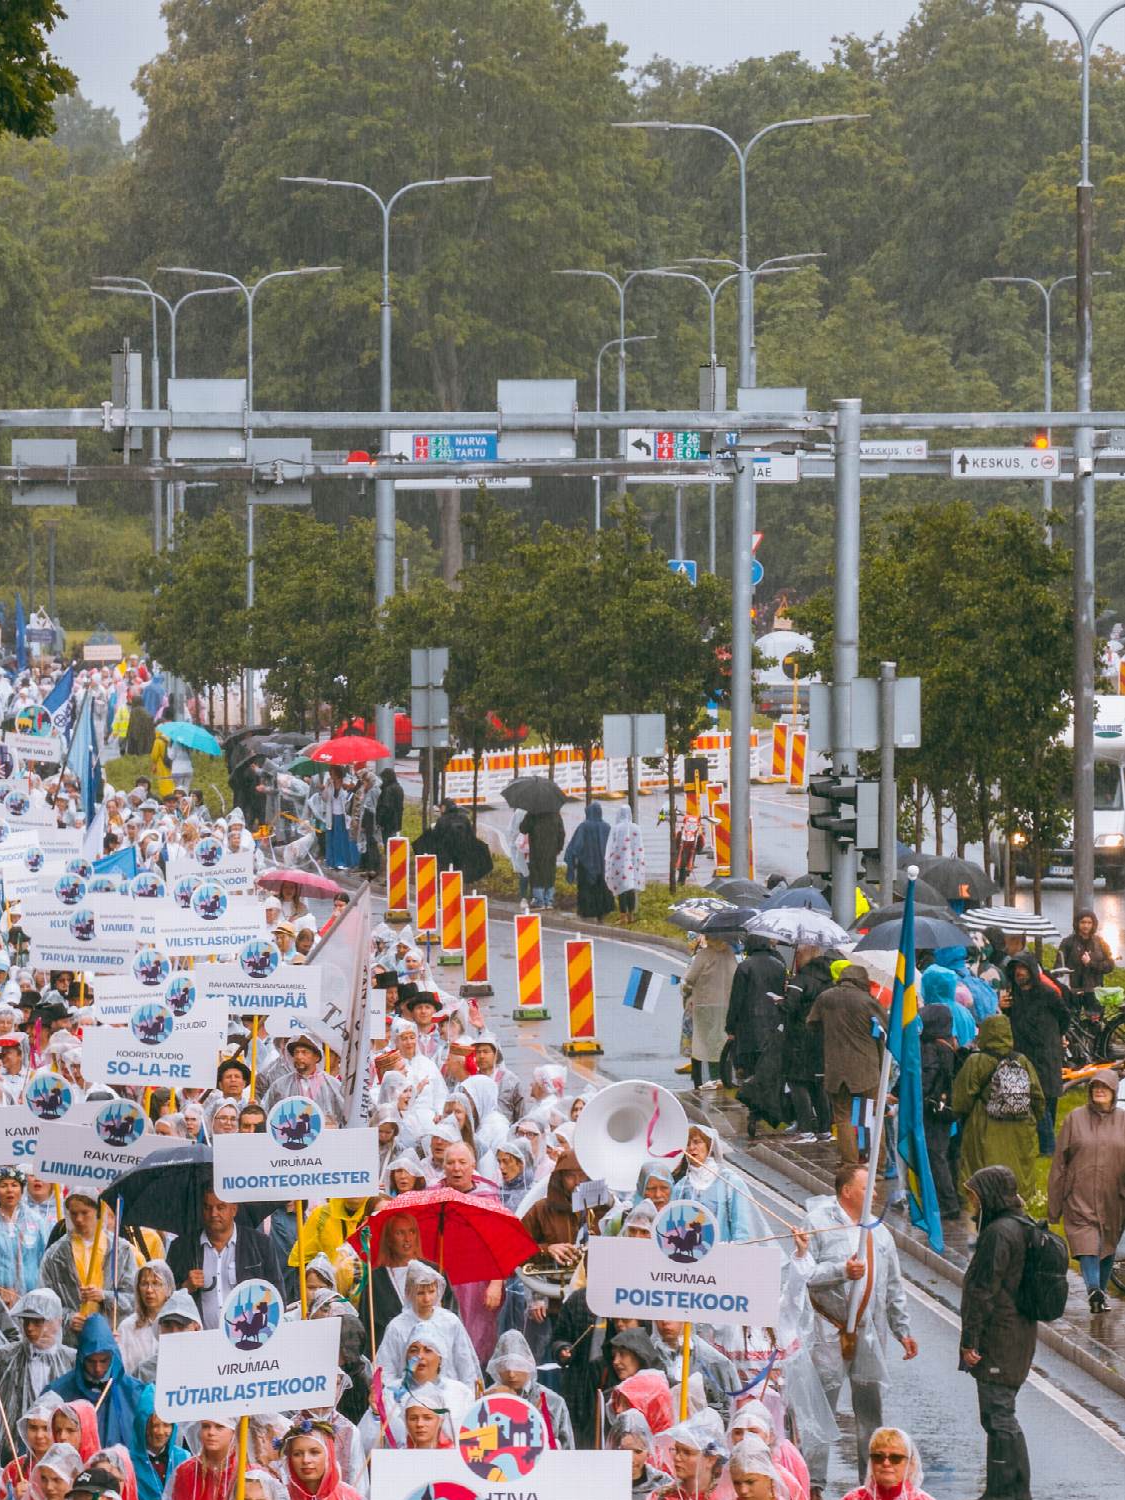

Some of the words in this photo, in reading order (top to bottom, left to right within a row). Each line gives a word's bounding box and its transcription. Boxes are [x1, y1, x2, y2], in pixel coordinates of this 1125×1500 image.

[455, 436, 487, 446] NARVA
[686, 432, 699, 444] 26
[455, 447, 486, 457] TARTU
[972, 456, 1022, 469] KESKUS,
[1030, 456, 1038, 468] C
[226, 876, 248, 885] KOOR
[40, 951, 76, 963] TARVA
[78, 954, 125, 966] TAMMED
[205, 992, 308, 1009] RVANPÄÄ
[174, 1020, 208, 1031] STUUDIO
[116, 1050, 184, 1061] KOORISTUUDIO
[107, 1060, 191, 1078] SO-LA-RE
[83, 1150, 143, 1166] RAKVERE
[270, 1157, 323, 1168] VIRUMAA
[222, 1171, 370, 1190] NOORTEORKESTER
[650, 1271, 717, 1285] VIRUMAA
[615, 1287, 749, 1312] POISTEKOOR
[217, 1359, 280, 1375] VIRUMAA
[165, 1375, 327, 1408] TÜTARLASTEKOOR
